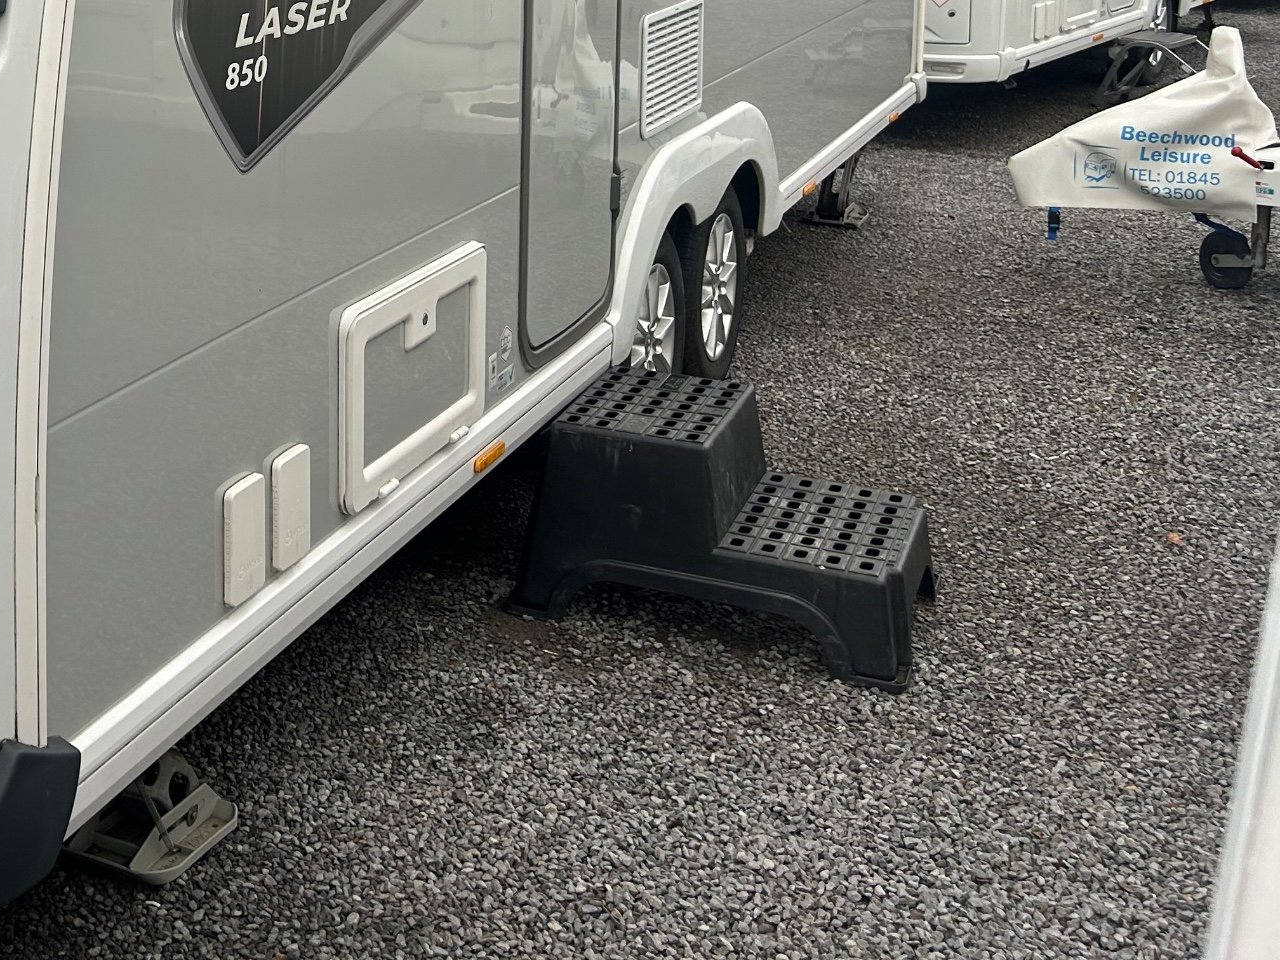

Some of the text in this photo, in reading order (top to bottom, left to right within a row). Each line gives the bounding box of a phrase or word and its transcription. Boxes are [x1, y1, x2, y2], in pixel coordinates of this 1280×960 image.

[225, 55, 268, 91] 850
[1120, 125, 1236, 148] Beechwood
[1139, 146, 1212, 165] Leisure
[1129, 167, 1221, 186] TEL: 01845
[1139, 185, 1207, 202] 523500
